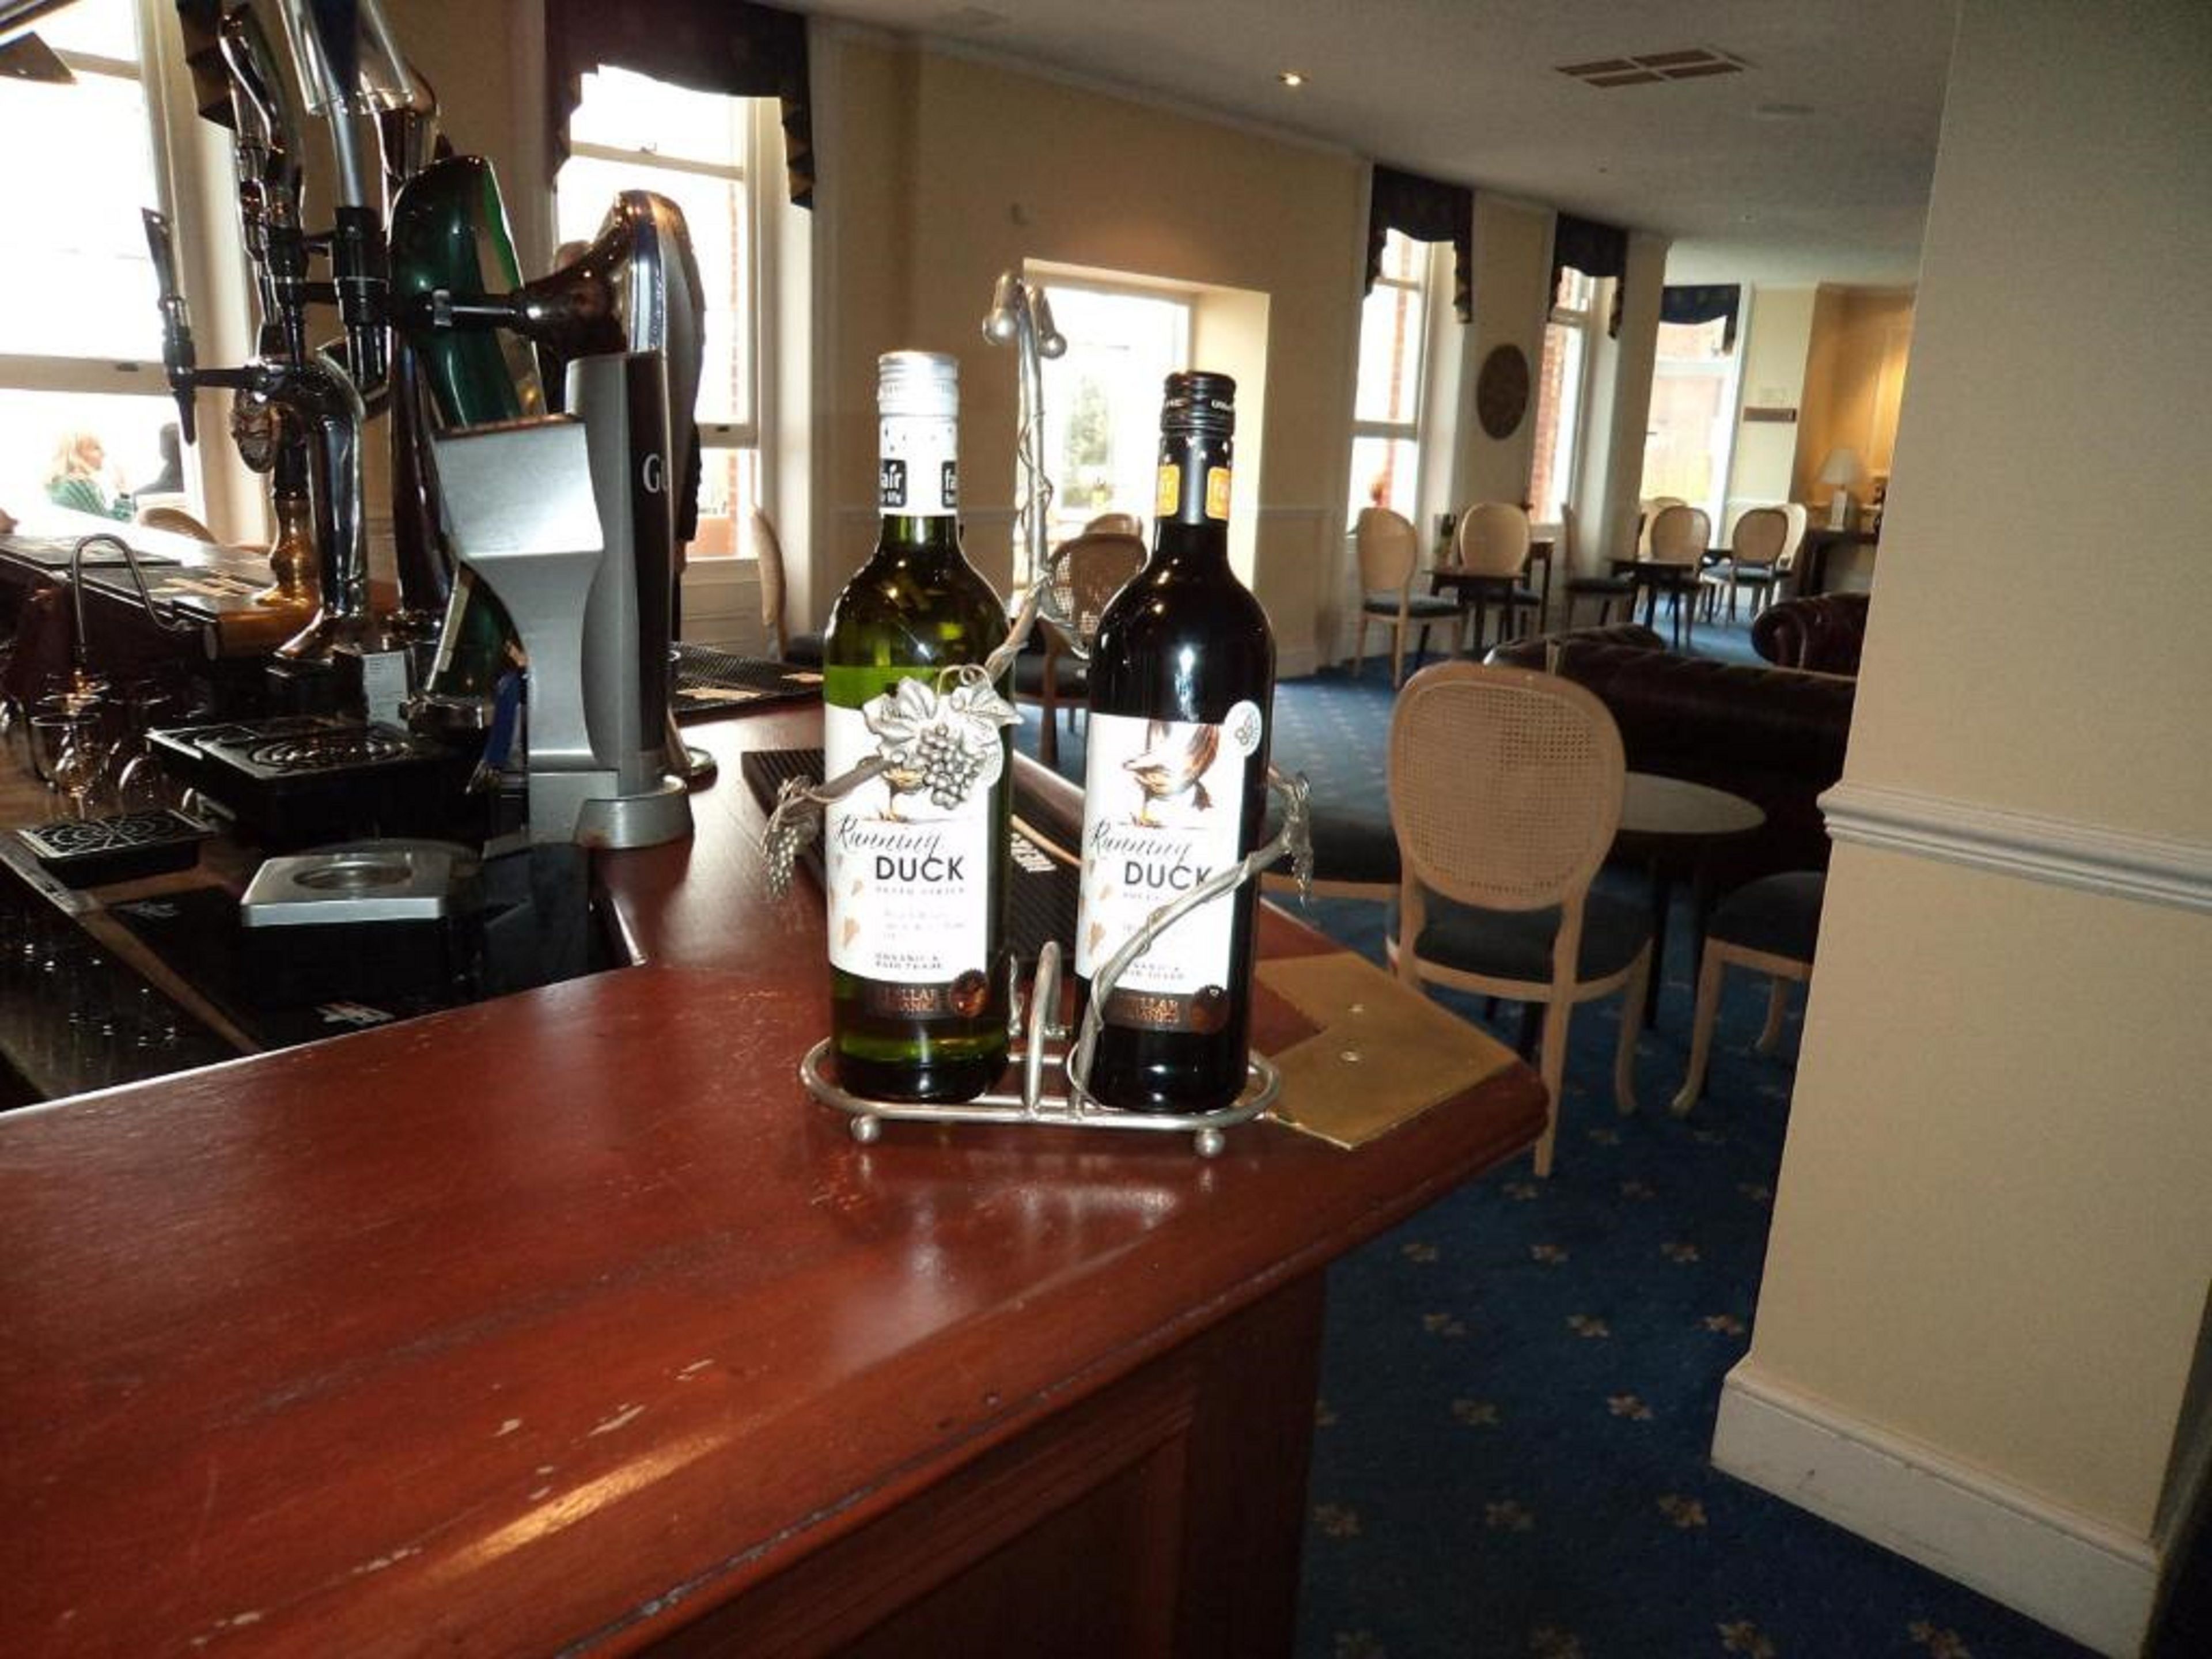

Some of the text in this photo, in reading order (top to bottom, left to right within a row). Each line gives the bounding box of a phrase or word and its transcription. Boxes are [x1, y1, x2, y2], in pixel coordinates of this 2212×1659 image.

[881, 464, 902, 489] air
[835, 814, 941, 858] Running
[1090, 819, 1192, 864] Running
[876, 855, 964, 882] DUCK
[1124, 861, 1213, 890] DUCK
